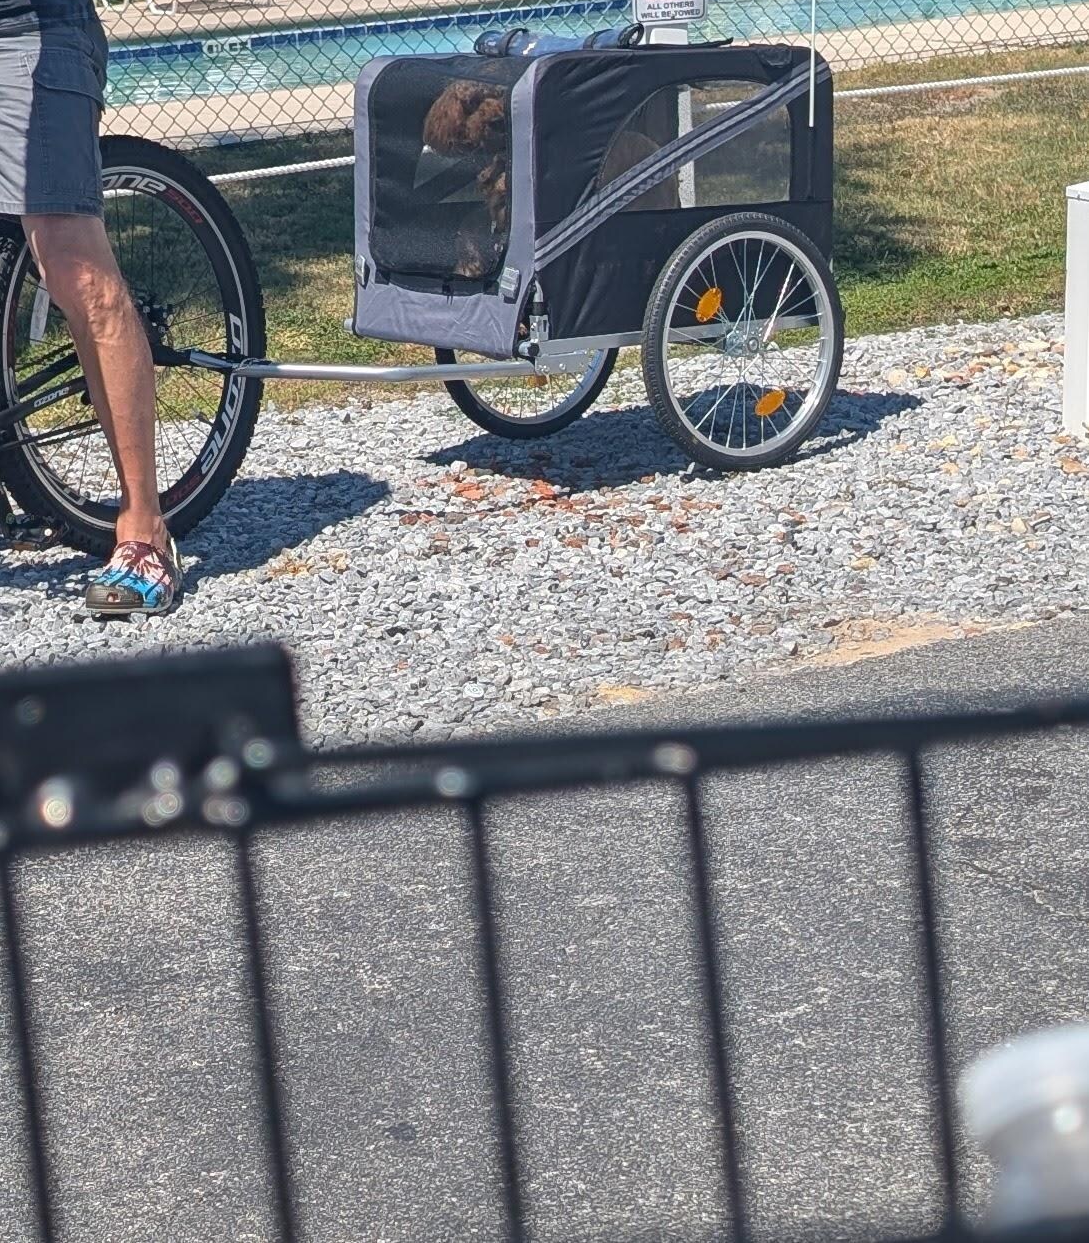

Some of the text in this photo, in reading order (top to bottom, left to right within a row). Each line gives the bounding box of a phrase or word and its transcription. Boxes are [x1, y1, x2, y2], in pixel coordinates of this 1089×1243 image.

[663, 0, 695, 9] OTHERS
[641, 11, 660, 19] WILL
[673, 8, 701, 17] TOWED
